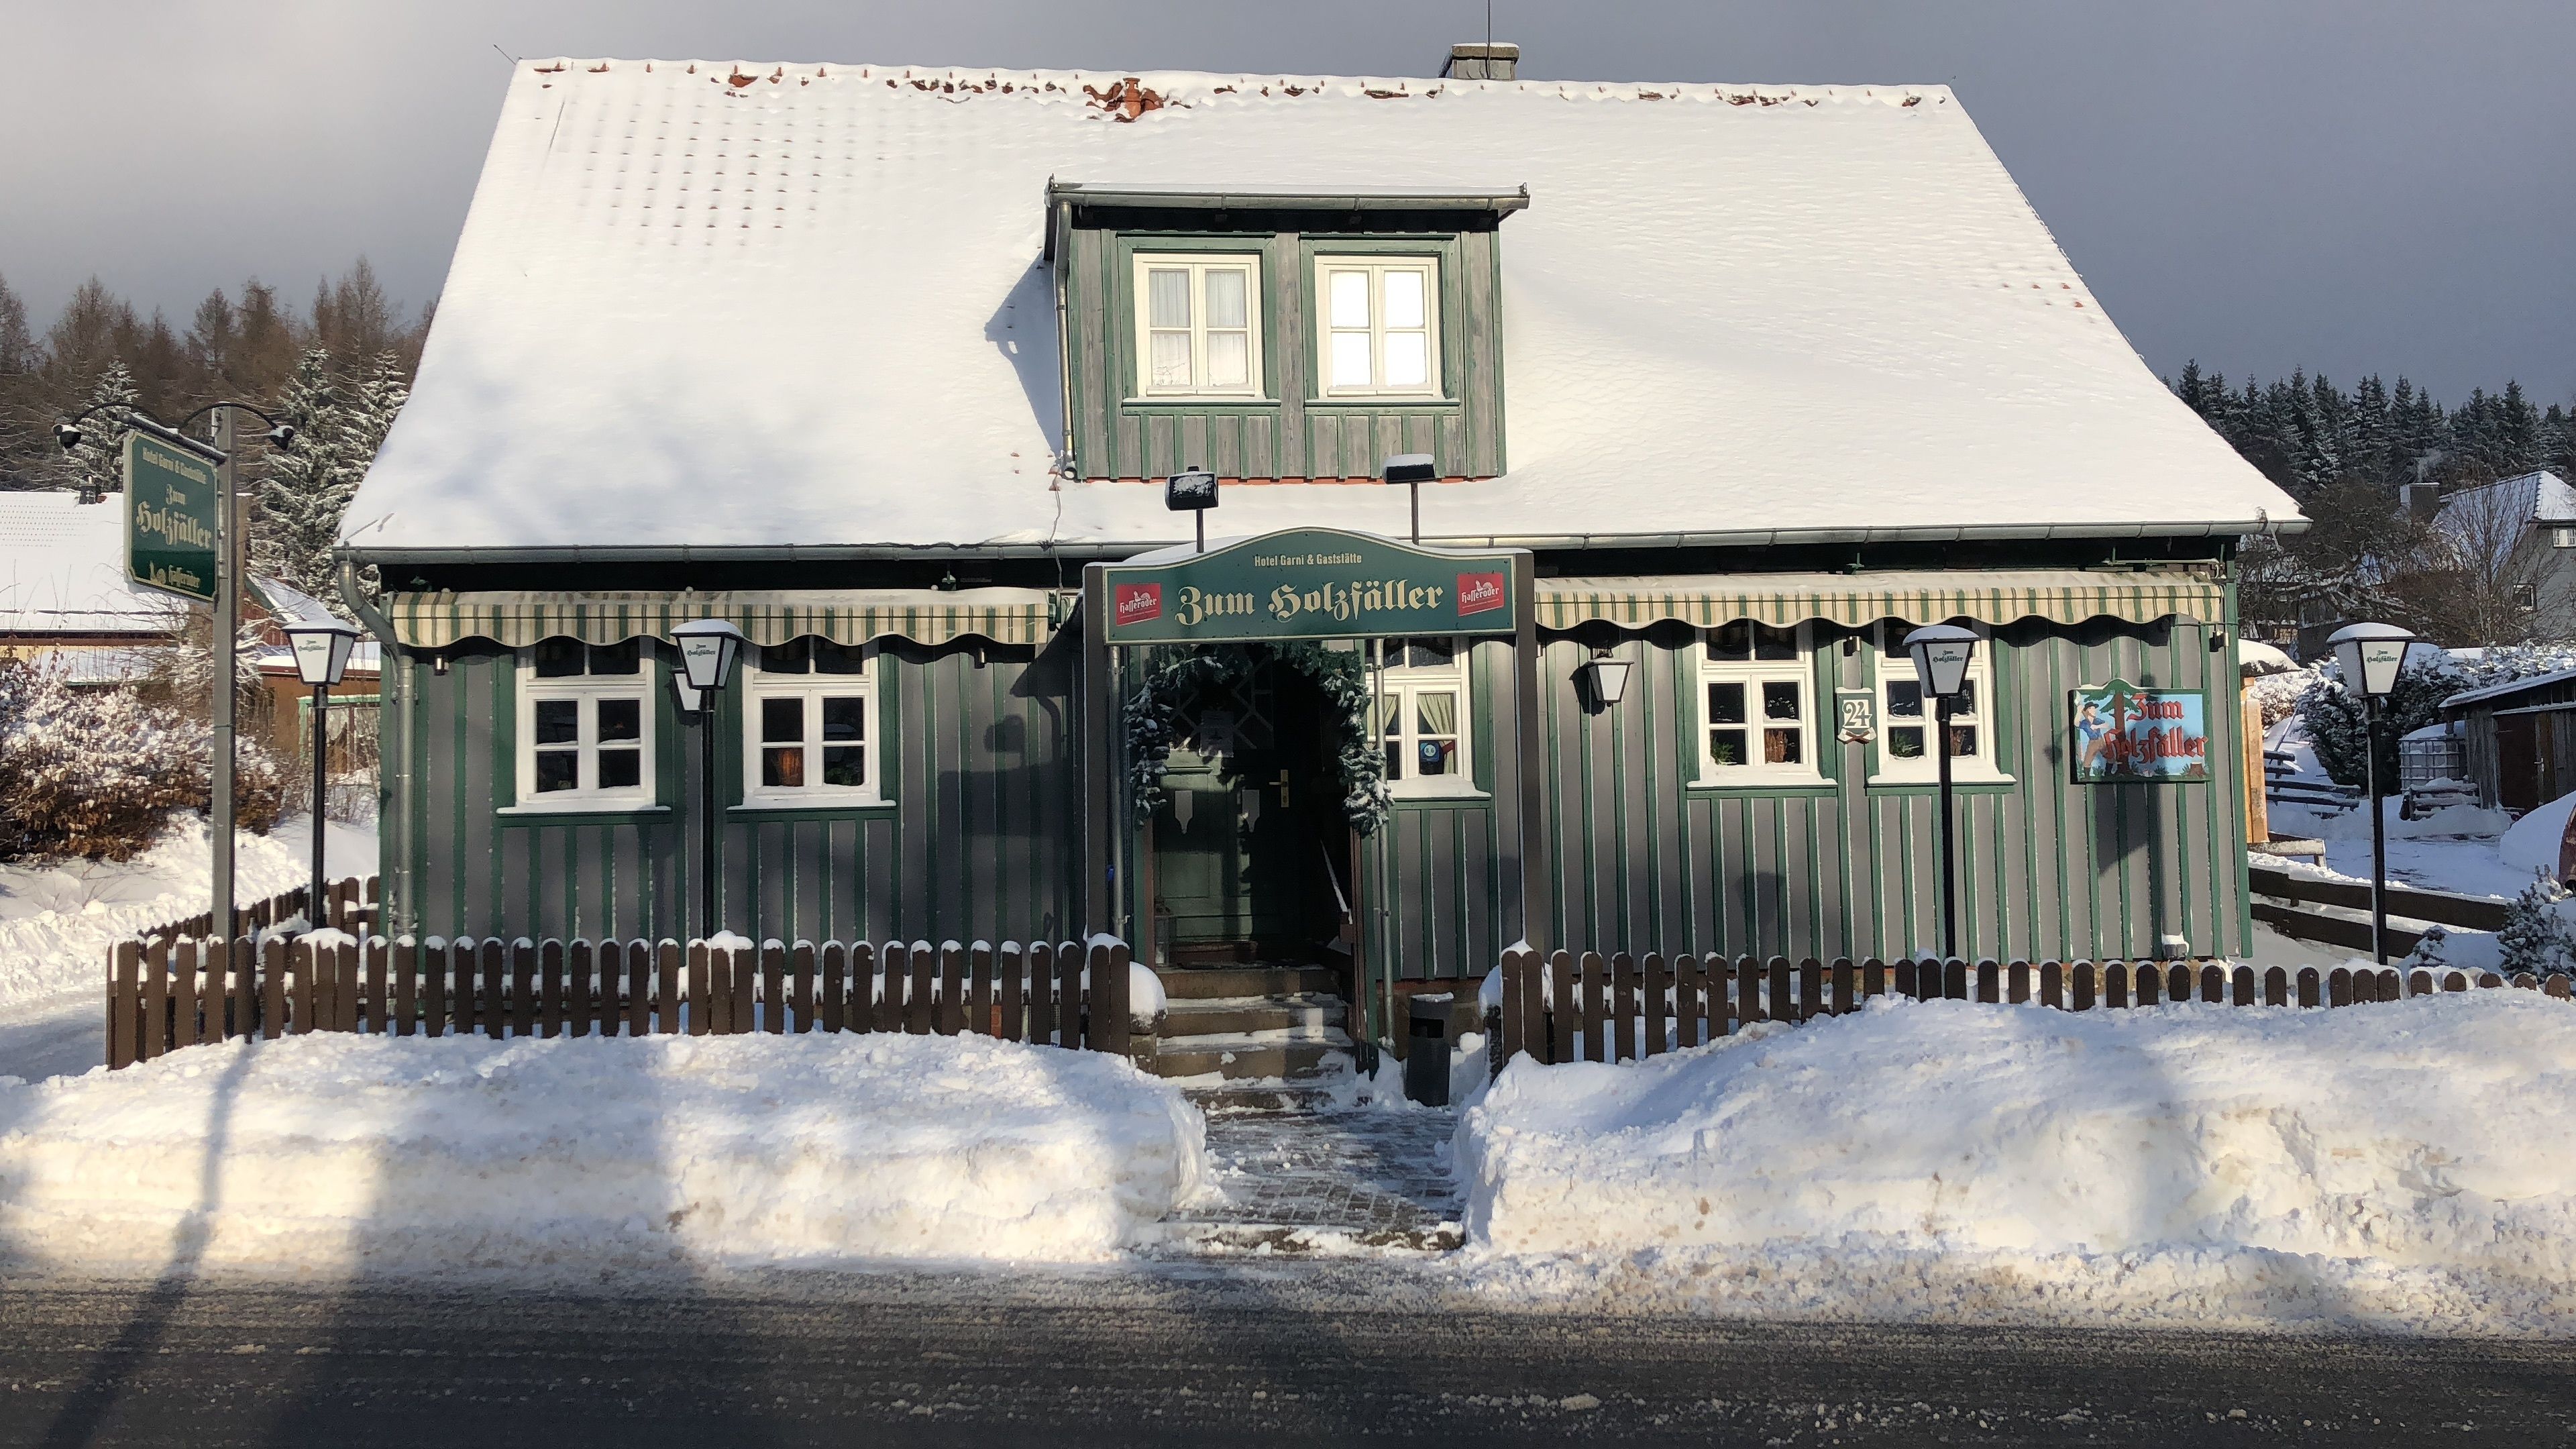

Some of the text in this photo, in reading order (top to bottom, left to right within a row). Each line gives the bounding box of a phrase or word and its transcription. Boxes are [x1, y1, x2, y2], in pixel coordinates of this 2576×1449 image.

[166, 484, 185, 506] Zum
[136, 500, 211, 549] Holzfäller
[1254, 553, 1362, 567] Hotel Garni & Gaststätte
[1175, 579, 1444, 625] Zum Holzfäller
[1842, 701, 1872, 727] 24
[2126, 692, 2184, 721] Zum
[2102, 725, 2209, 764] Holzfäller
